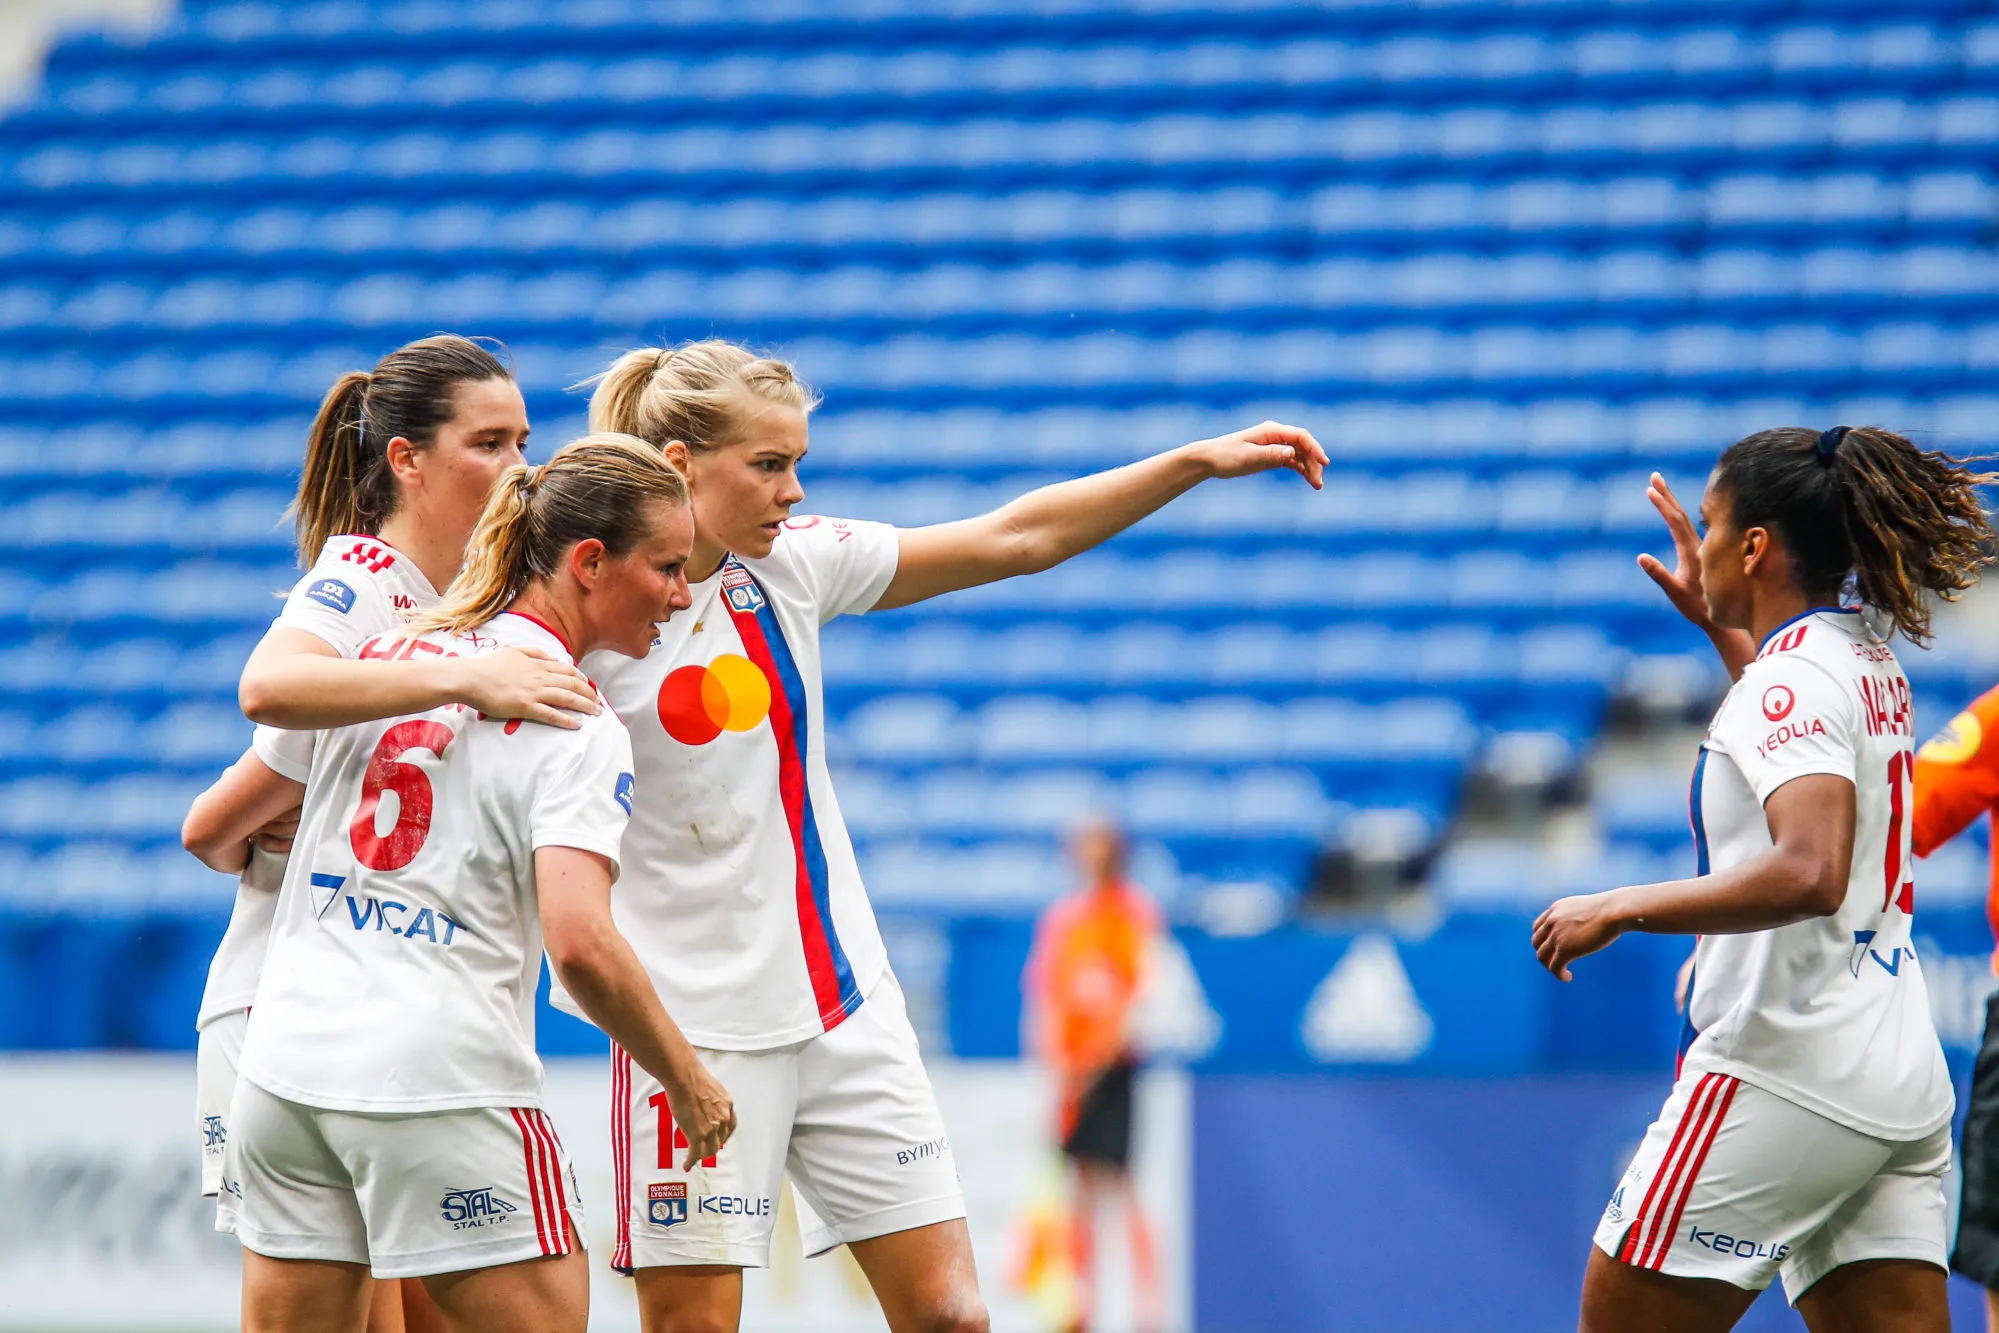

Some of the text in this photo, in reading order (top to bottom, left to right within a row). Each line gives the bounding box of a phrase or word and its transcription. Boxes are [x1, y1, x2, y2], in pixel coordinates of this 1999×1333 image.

[322, 582, 345, 598] D1
[1757, 719, 1827, 758] VEOLIA
[349, 719, 455, 872] 6
[345, 895, 468, 946] VICAT
[650, 1184, 685, 1192] OLYMPIQUE
[650, 1190, 685, 1198] LYONNAIS
[440, 1187, 502, 1222] STAL
[651, 1200, 686, 1221] OL
[453, 1214, 510, 1231] STAL T.P.
